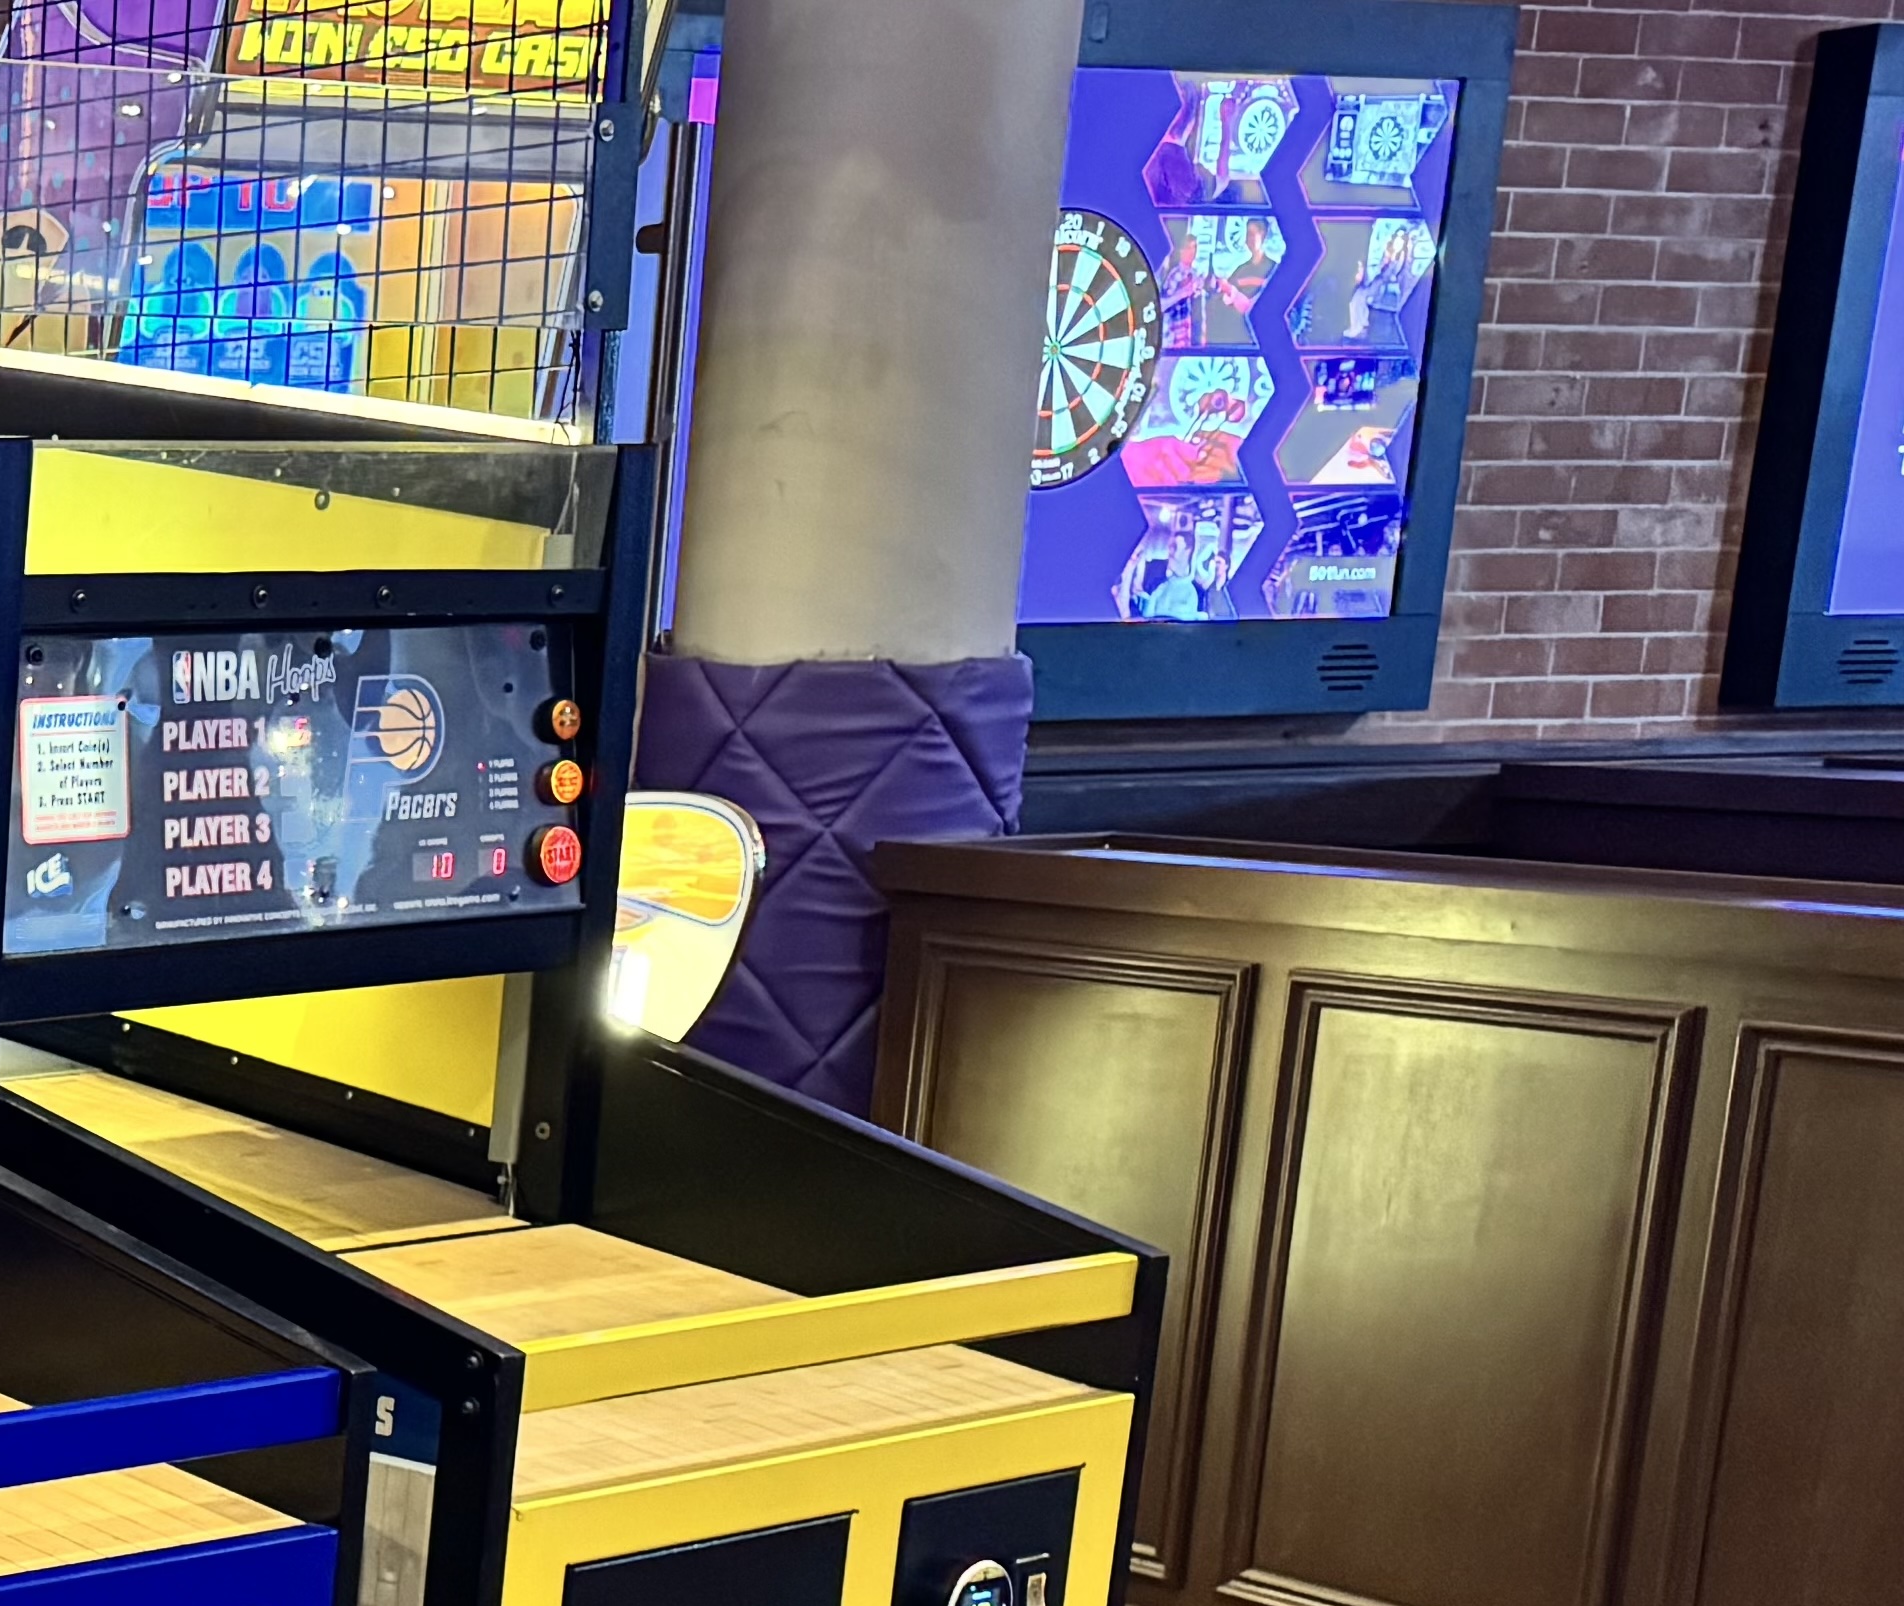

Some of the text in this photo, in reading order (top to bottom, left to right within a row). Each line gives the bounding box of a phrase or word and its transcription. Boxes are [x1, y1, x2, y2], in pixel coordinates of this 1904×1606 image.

[193, 643, 335, 703] NBA Hoops
[162, 717, 266, 752] PLAYER 1
[163, 766, 270, 802] PLAYER 2
[385, 791, 457, 821] Pacers
[164, 812, 270, 850] PLAYER 3
[27, 853, 70, 894] ICE
[165, 860, 272, 898] PLAYER 4
[432, 852, 454, 878] 10
[492, 848, 506, 875] 0
